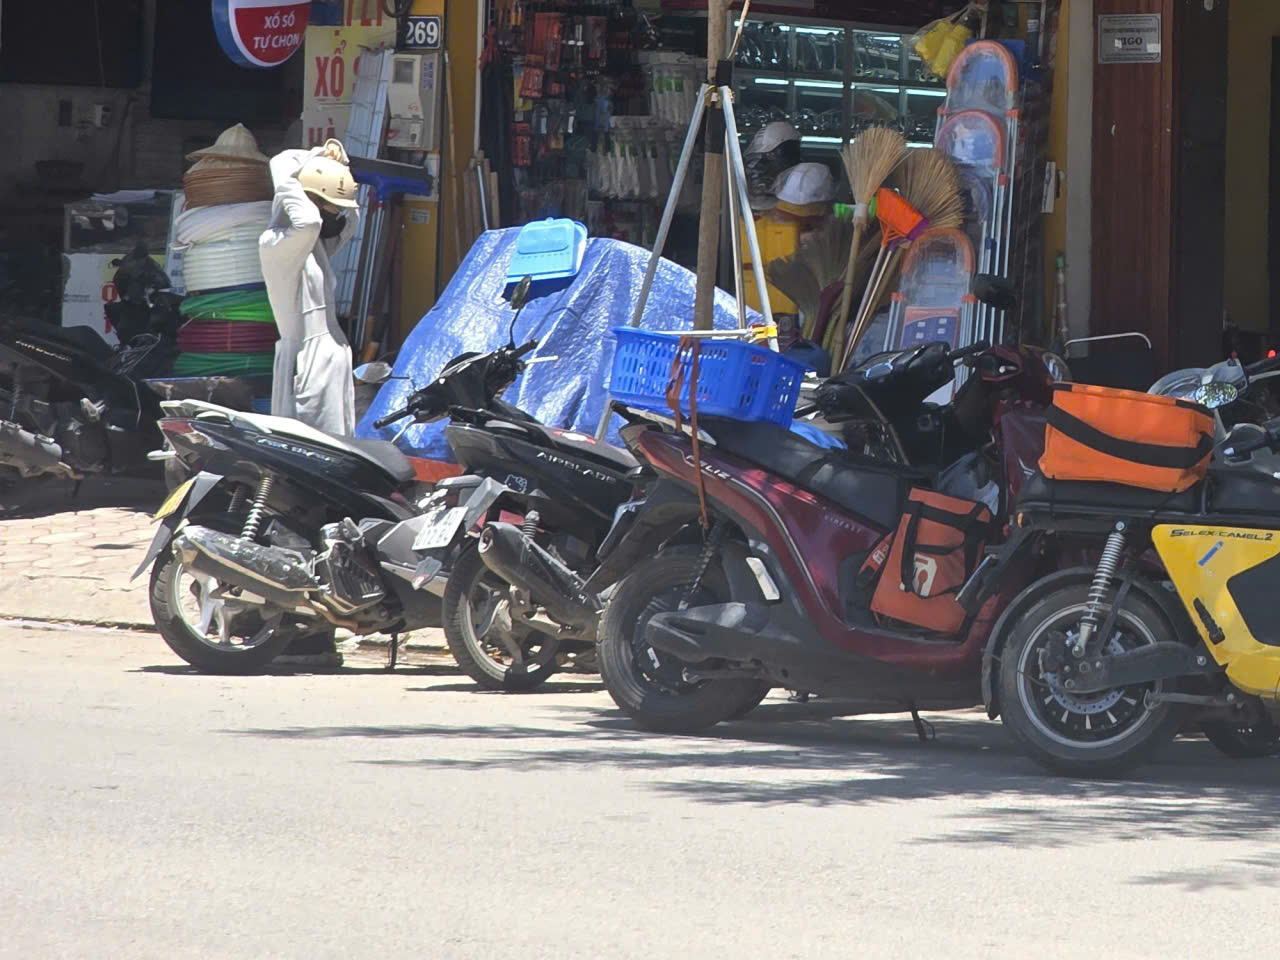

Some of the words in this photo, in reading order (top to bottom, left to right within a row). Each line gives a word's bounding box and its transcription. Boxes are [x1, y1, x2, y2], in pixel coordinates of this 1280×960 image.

[253, 34, 272, 53] TỰ
[406, 21, 439, 44] 269
[313, 40, 346, 97] XỔ
